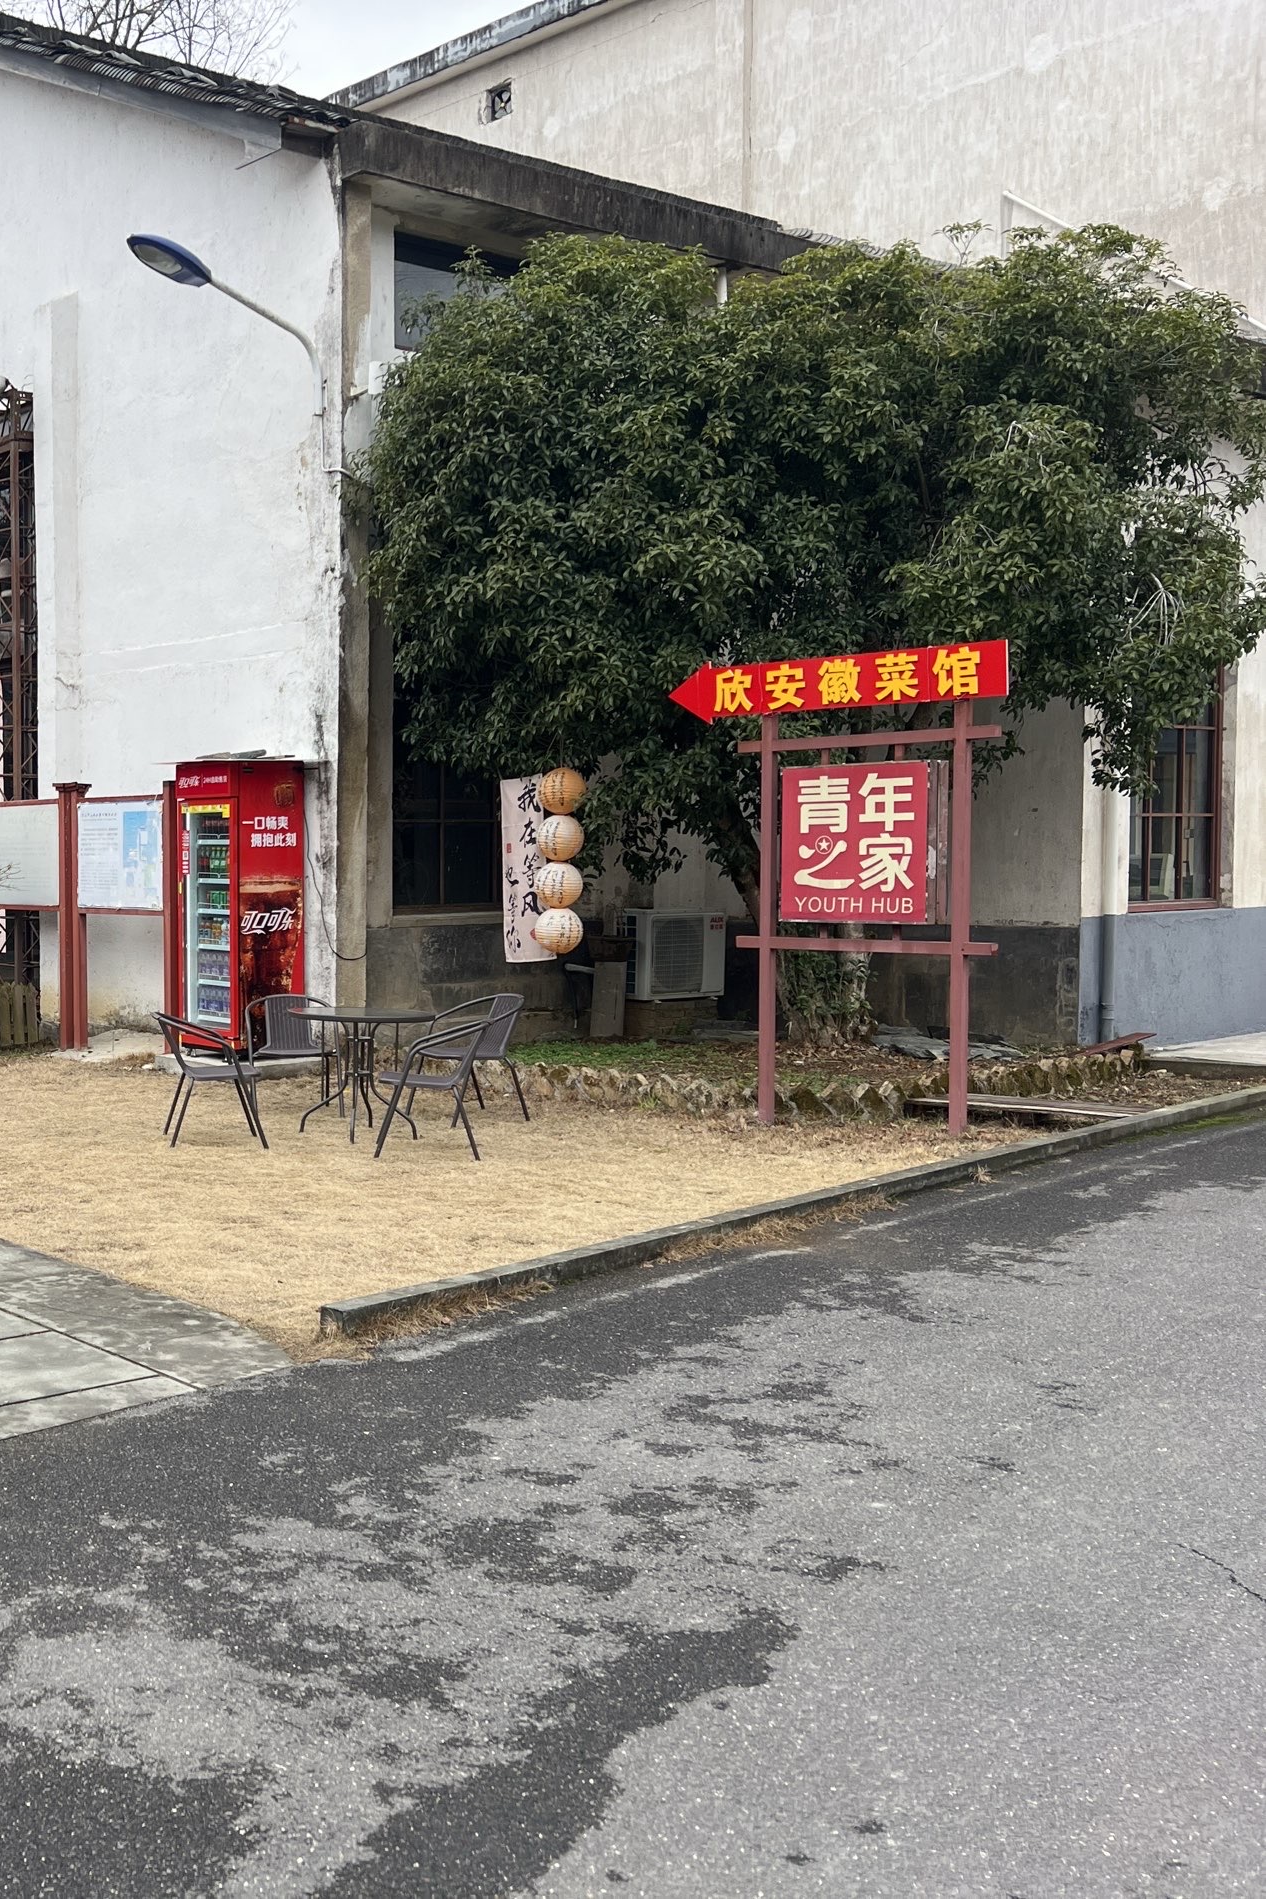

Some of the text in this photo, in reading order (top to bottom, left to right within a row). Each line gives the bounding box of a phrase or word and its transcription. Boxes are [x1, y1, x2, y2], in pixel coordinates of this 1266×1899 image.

[713, 647, 981, 712] 欣安徽菜馆
[241, 815, 289, 830] 一口畅爽
[797, 772, 915, 834] 青年
[250, 832, 297, 848] 拥抱此刻
[517, 782, 543, 918] 我在等风
[793, 833, 915, 892] 之家
[240, 907, 297, 935] 可口可乐
[505, 865, 521, 953] 也等你
[794, 896, 914, 914] YOUTH HUB
